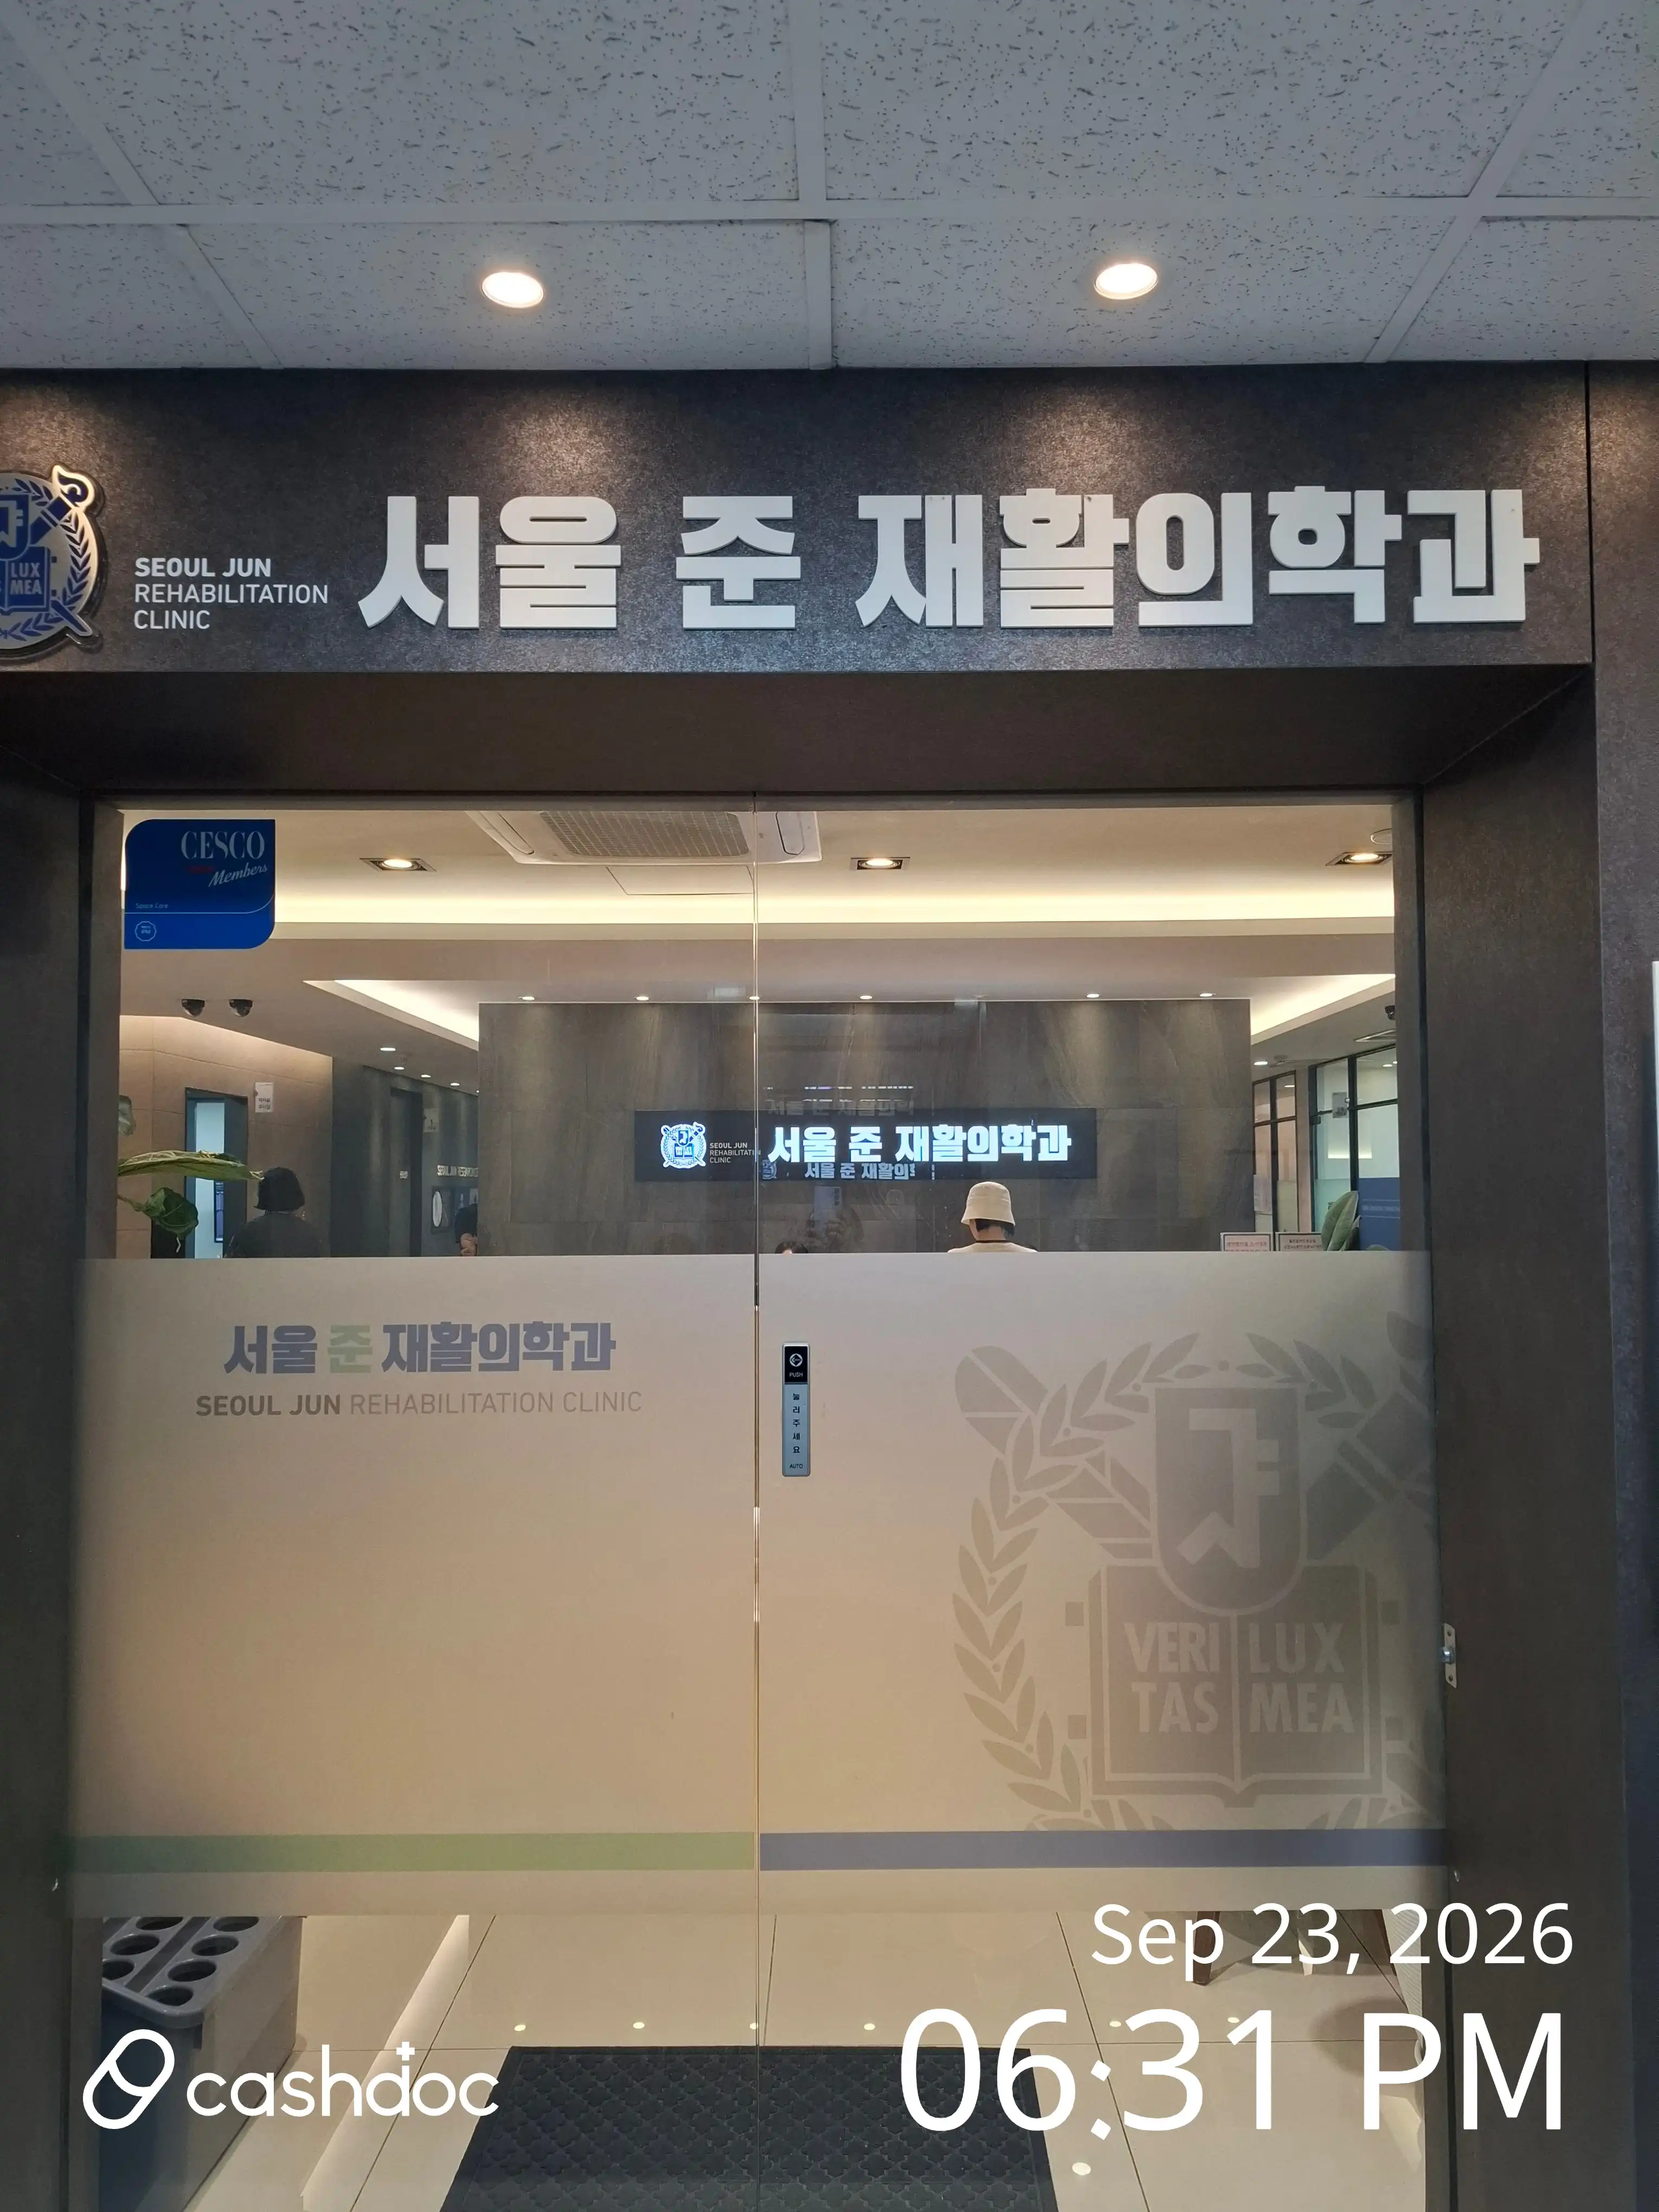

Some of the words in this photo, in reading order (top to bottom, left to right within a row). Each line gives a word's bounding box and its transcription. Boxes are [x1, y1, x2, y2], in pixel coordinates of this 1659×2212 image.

[10, 562, 40, 578] LUX
[134, 557, 216, 577] SEOUL
[222, 557, 272, 577] JUN
[358, 496, 621, 629] 서울
[676, 496, 801, 630] 준
[854, 486, 1540, 627] 재활의학과
[10, 580, 42, 595] MEA
[134, 584, 328, 604] REHABILITATION
[134, 609, 210, 629] CLINIC
[181, 831, 265, 859] CESCO
[208, 863, 268, 888] Members
[768, 1126, 837, 1163] 서울
[848, 1126, 883, 1162] 준
[895, 1124, 1072, 1162] 재활의학과
[805, 1162, 835, 1179] 서울
[840, 1163, 855, 1179] 준
[224, 1325, 318, 1374] 서울
[327, 1324, 372, 1373] 준
[382, 1321, 616, 1373] 재활의학과
[196, 1394, 281, 1417] SEOUL
[289, 1394, 341, 1416] JUN
[351, 1392, 554, 1415] REHABILITATION
[562, 1391, 641, 1413] CLINIC
[1124, 1622, 1219, 1673] VERI
[1250, 1622, 1345, 1673] LUX
[1131, 1682, 1218, 1733] TAS
[1250, 1682, 1355, 1733] MEA
